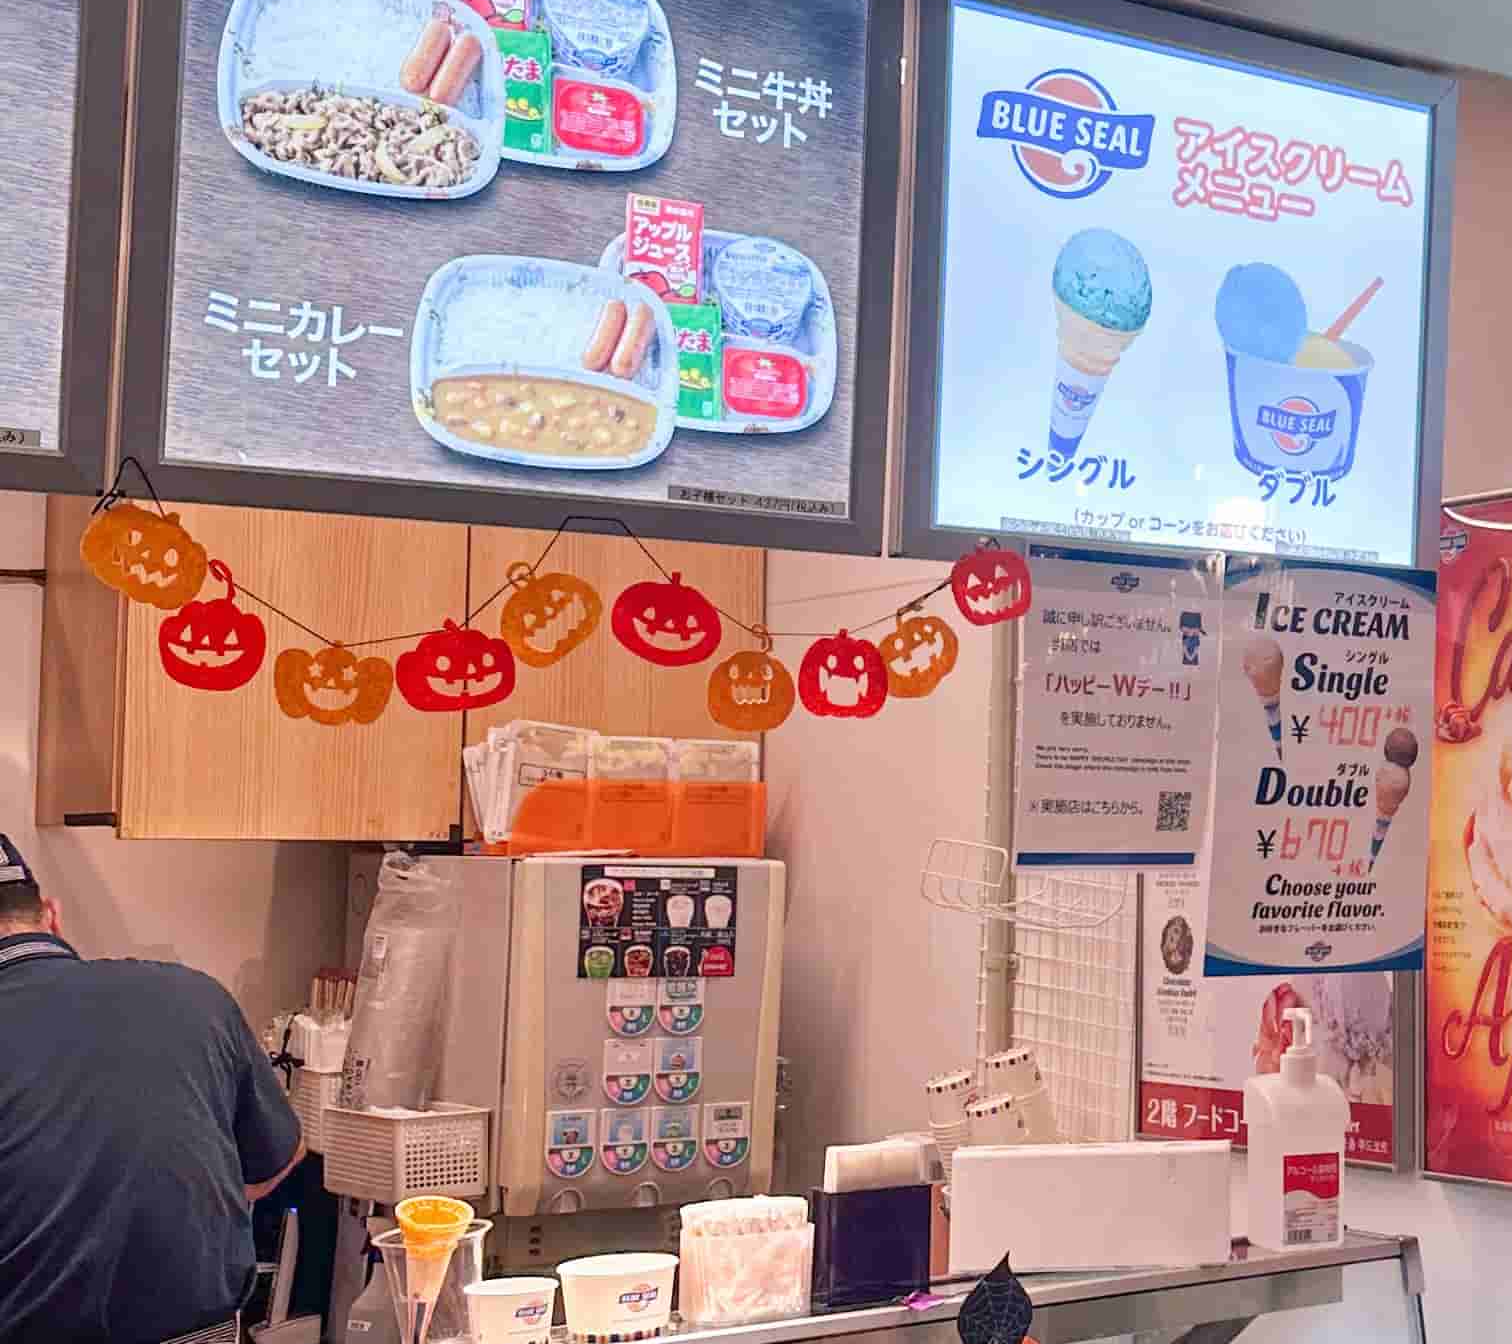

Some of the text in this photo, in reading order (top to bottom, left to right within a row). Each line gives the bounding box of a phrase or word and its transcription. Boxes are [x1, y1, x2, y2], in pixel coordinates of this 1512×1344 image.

[695, 57, 834, 119] ミニ牛丼
[712, 102, 808, 149] セット
[991, 99, 1145, 158] BLUE SEAL
[1173, 117, 1413, 207] アイスクリーム
[1172, 162, 1316, 222] メニュー
[203, 290, 404, 345] ミニカレー
[674, 326, 713, 354] たま
[241, 340, 358, 388] セット
[1260, 410, 1336, 436] BLUE SEAL
[1257, 469, 1338, 508] ダブル
[1254, 592, 1411, 641] ICE CREAM
[1335, 592, 1411, 610] アイスクリーム
[1291, 652, 1389, 701] Single
[1319, 705, 1383, 749] 400
[1255, 766, 1370, 808] Double
[1265, 872, 1377, 900] Choose your
[1251, 899, 1386, 920] favorite flavor.
[1147, 1098, 1248, 1134] 2階 フードコ
